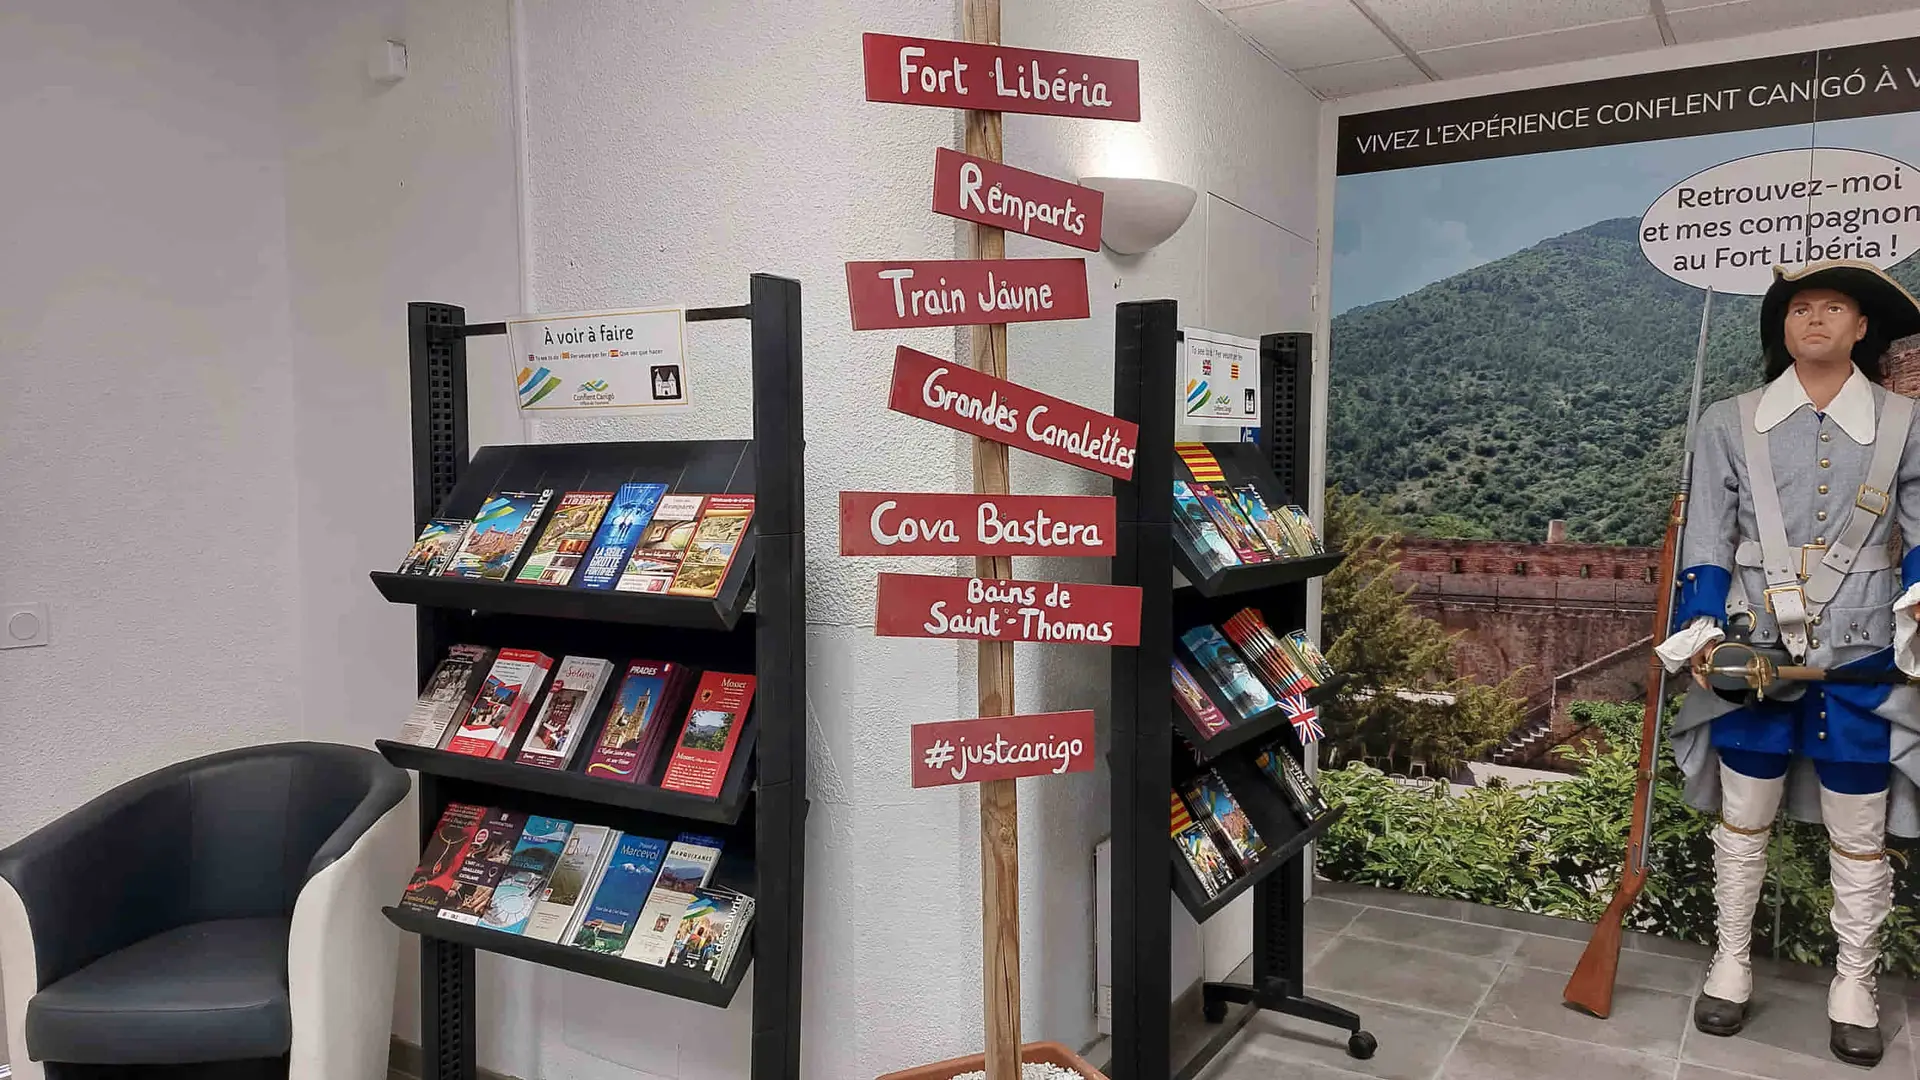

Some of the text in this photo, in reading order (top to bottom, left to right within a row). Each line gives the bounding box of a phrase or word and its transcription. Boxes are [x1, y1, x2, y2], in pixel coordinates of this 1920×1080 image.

[900, 47, 1112, 107] Fort Libéria
[1356, 129, 1420, 155] VIVEZ
[1426, 106, 1590, 146] L'EXPÉRIENCE
[1596, 88, 1742, 125] CONFLENT
[1748, 68, 1866, 108] CANIGÓ
[1874, 65, 1898, 92] À
[959, 162, 1086, 236] Remparts
[1677, 166, 1903, 210] Retrouvez-moi
[1642, 222, 1670, 243] et
[1675, 219, 1732, 241] mes
[1673, 252, 1706, 272] au
[1714, 247, 1772, 269] Fort
[1779, 234, 1882, 265] Libéria
[878, 268, 967, 318] Train
[544, 324, 634, 345] À voir à faire
[922, 367, 1136, 469] Grandes Canalettes
[523, 489, 553, 523] faire
[870, 500, 1103, 547] Cova Bastera
[967, 578, 1072, 609] Bains de
[924, 601, 1113, 642] Saint-Thomas
[629, 665, 658, 676] PRADES
[924, 733, 1083, 780] #justcanigo
[620, 844, 660, 861] Marcevol
[714, 895, 743, 951] découvrir
